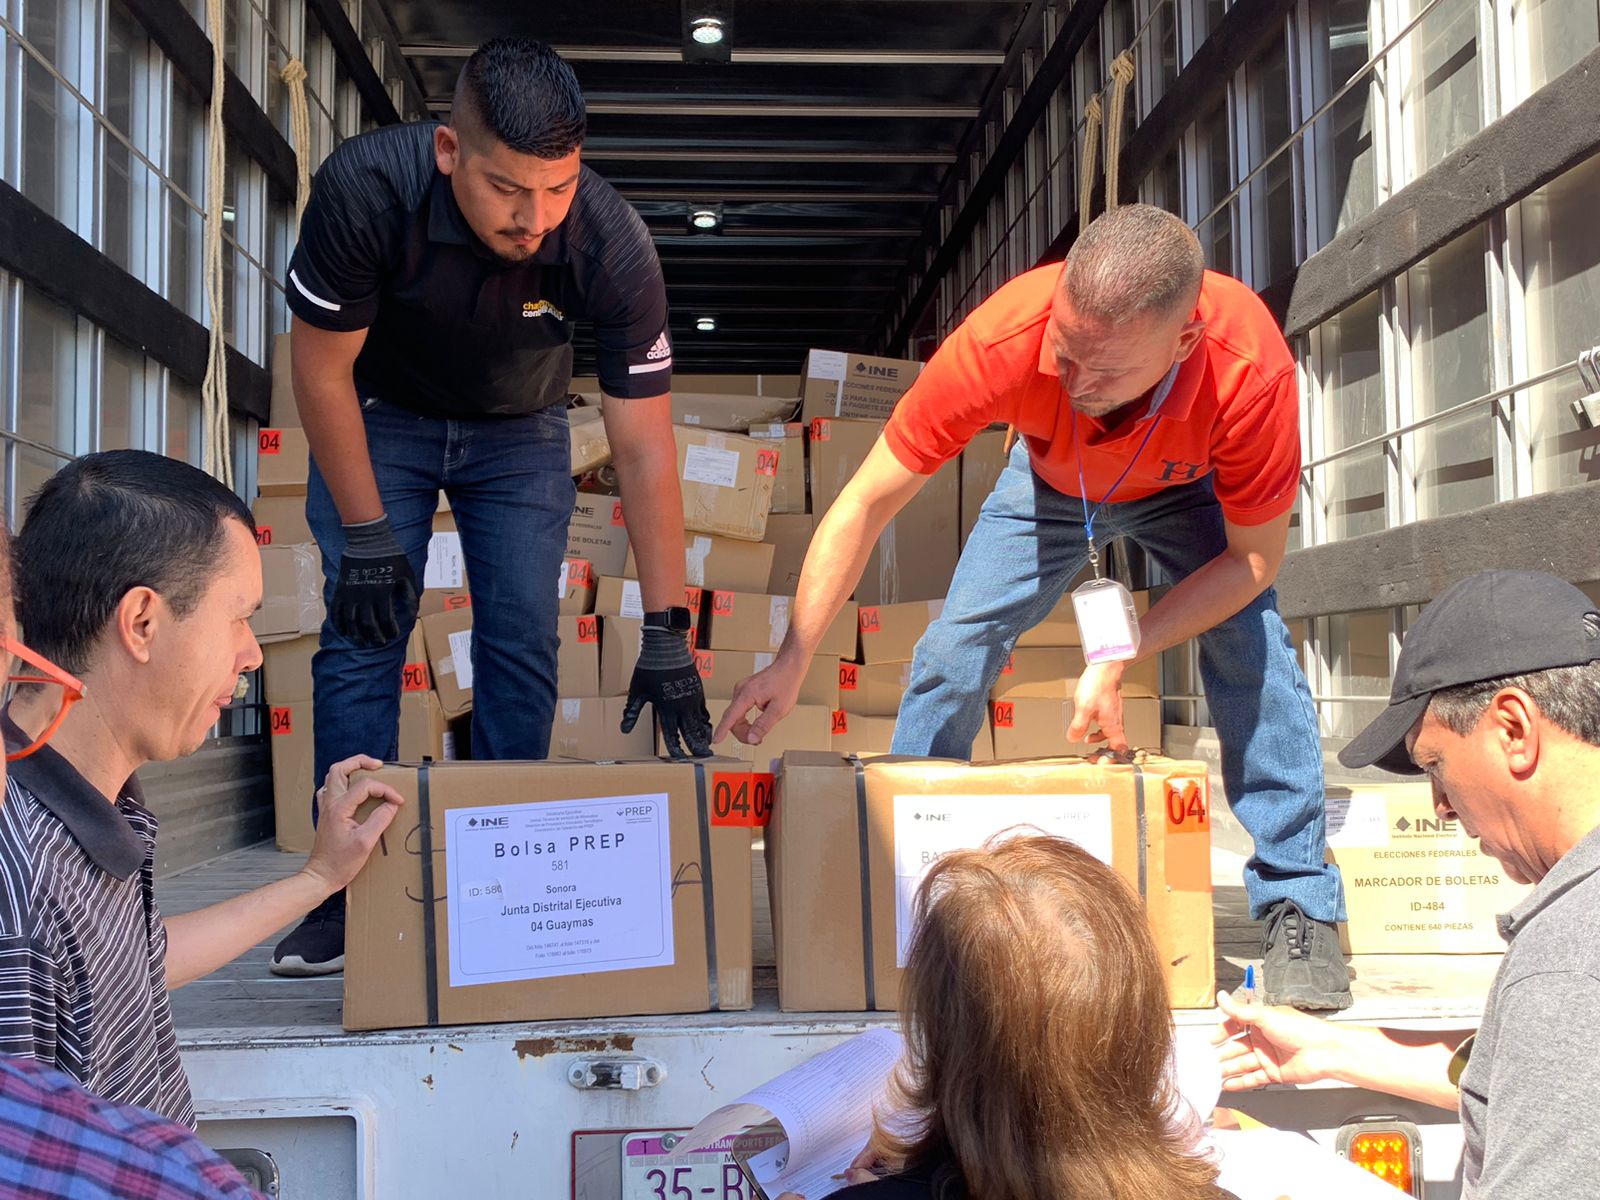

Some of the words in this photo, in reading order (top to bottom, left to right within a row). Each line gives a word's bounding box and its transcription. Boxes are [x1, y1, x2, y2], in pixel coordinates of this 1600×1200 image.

[869, 366, 899, 378] INE
[260, 434, 280, 450] 04
[757, 454, 774, 470] 04
[1154, 459, 1205, 481] H
[575, 505, 594, 515] NE
[613, 506, 622, 520] 0
[582, 537, 612, 546] BOLETAS
[569, 563, 587, 581] 04
[714, 594, 732, 611] 04
[861, 611, 879, 628] 04
[578, 621, 597, 638] 04
[403, 668, 423, 686] 04
[839, 668, 857, 686] 04
[272, 711, 291, 730] 04
[995, 705, 1013, 724] 04
[714, 780, 751, 818] 04
[625, 806, 653, 816] PREP
[1167, 791, 1206, 825] 04
[481, 816, 509, 827] INE
[926, 812, 952, 822] INE
[1415, 818, 1457, 832] INE
[494, 840, 556, 859] Bolsa
[569, 832, 626, 852] PREP
[1373, 850, 1426, 859] ELECCIONES
[1428, 849, 1478, 858] FEDERALES
[551, 860, 569, 871] 581
[1354, 877, 1423, 888] MARCADOR
[1426, 876, 1441, 886] DE
[1445, 875, 1499, 886] BOLETAS
[468, 887, 483, 897] ID:
[546, 884, 577, 894] Sonora
[501, 905, 530, 917] Junta
[532, 899, 573, 914] Distrital
[575, 895, 622, 912] Ejecutiva
[1410, 901, 1446, 912] ID-484
[530, 920, 544, 932] 04
[545, 917, 594, 932] Guaymas
[1384, 923, 1427, 932] CONTIENE
[1428, 923, 1442, 931] 640
[1444, 922, 1474, 931] PIEZAS
[641, 1140, 649, 1154] T
